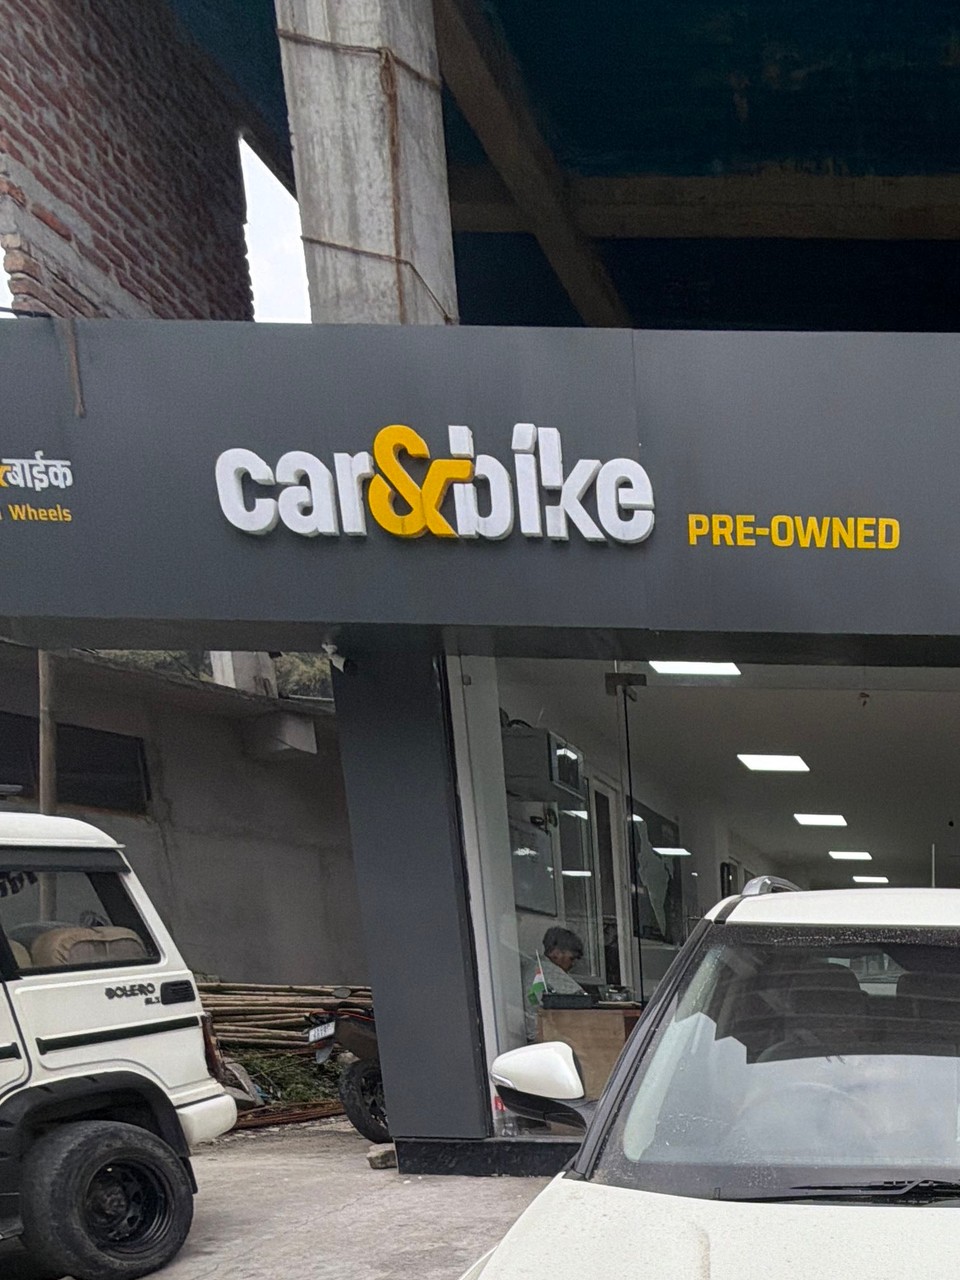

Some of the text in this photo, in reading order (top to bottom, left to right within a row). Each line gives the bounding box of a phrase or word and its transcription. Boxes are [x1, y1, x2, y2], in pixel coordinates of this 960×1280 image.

[215, 423, 655, 544] car&bike
[7, 503, 73, 522] Wheels
[688, 513, 900, 549] PRE-OWNED
